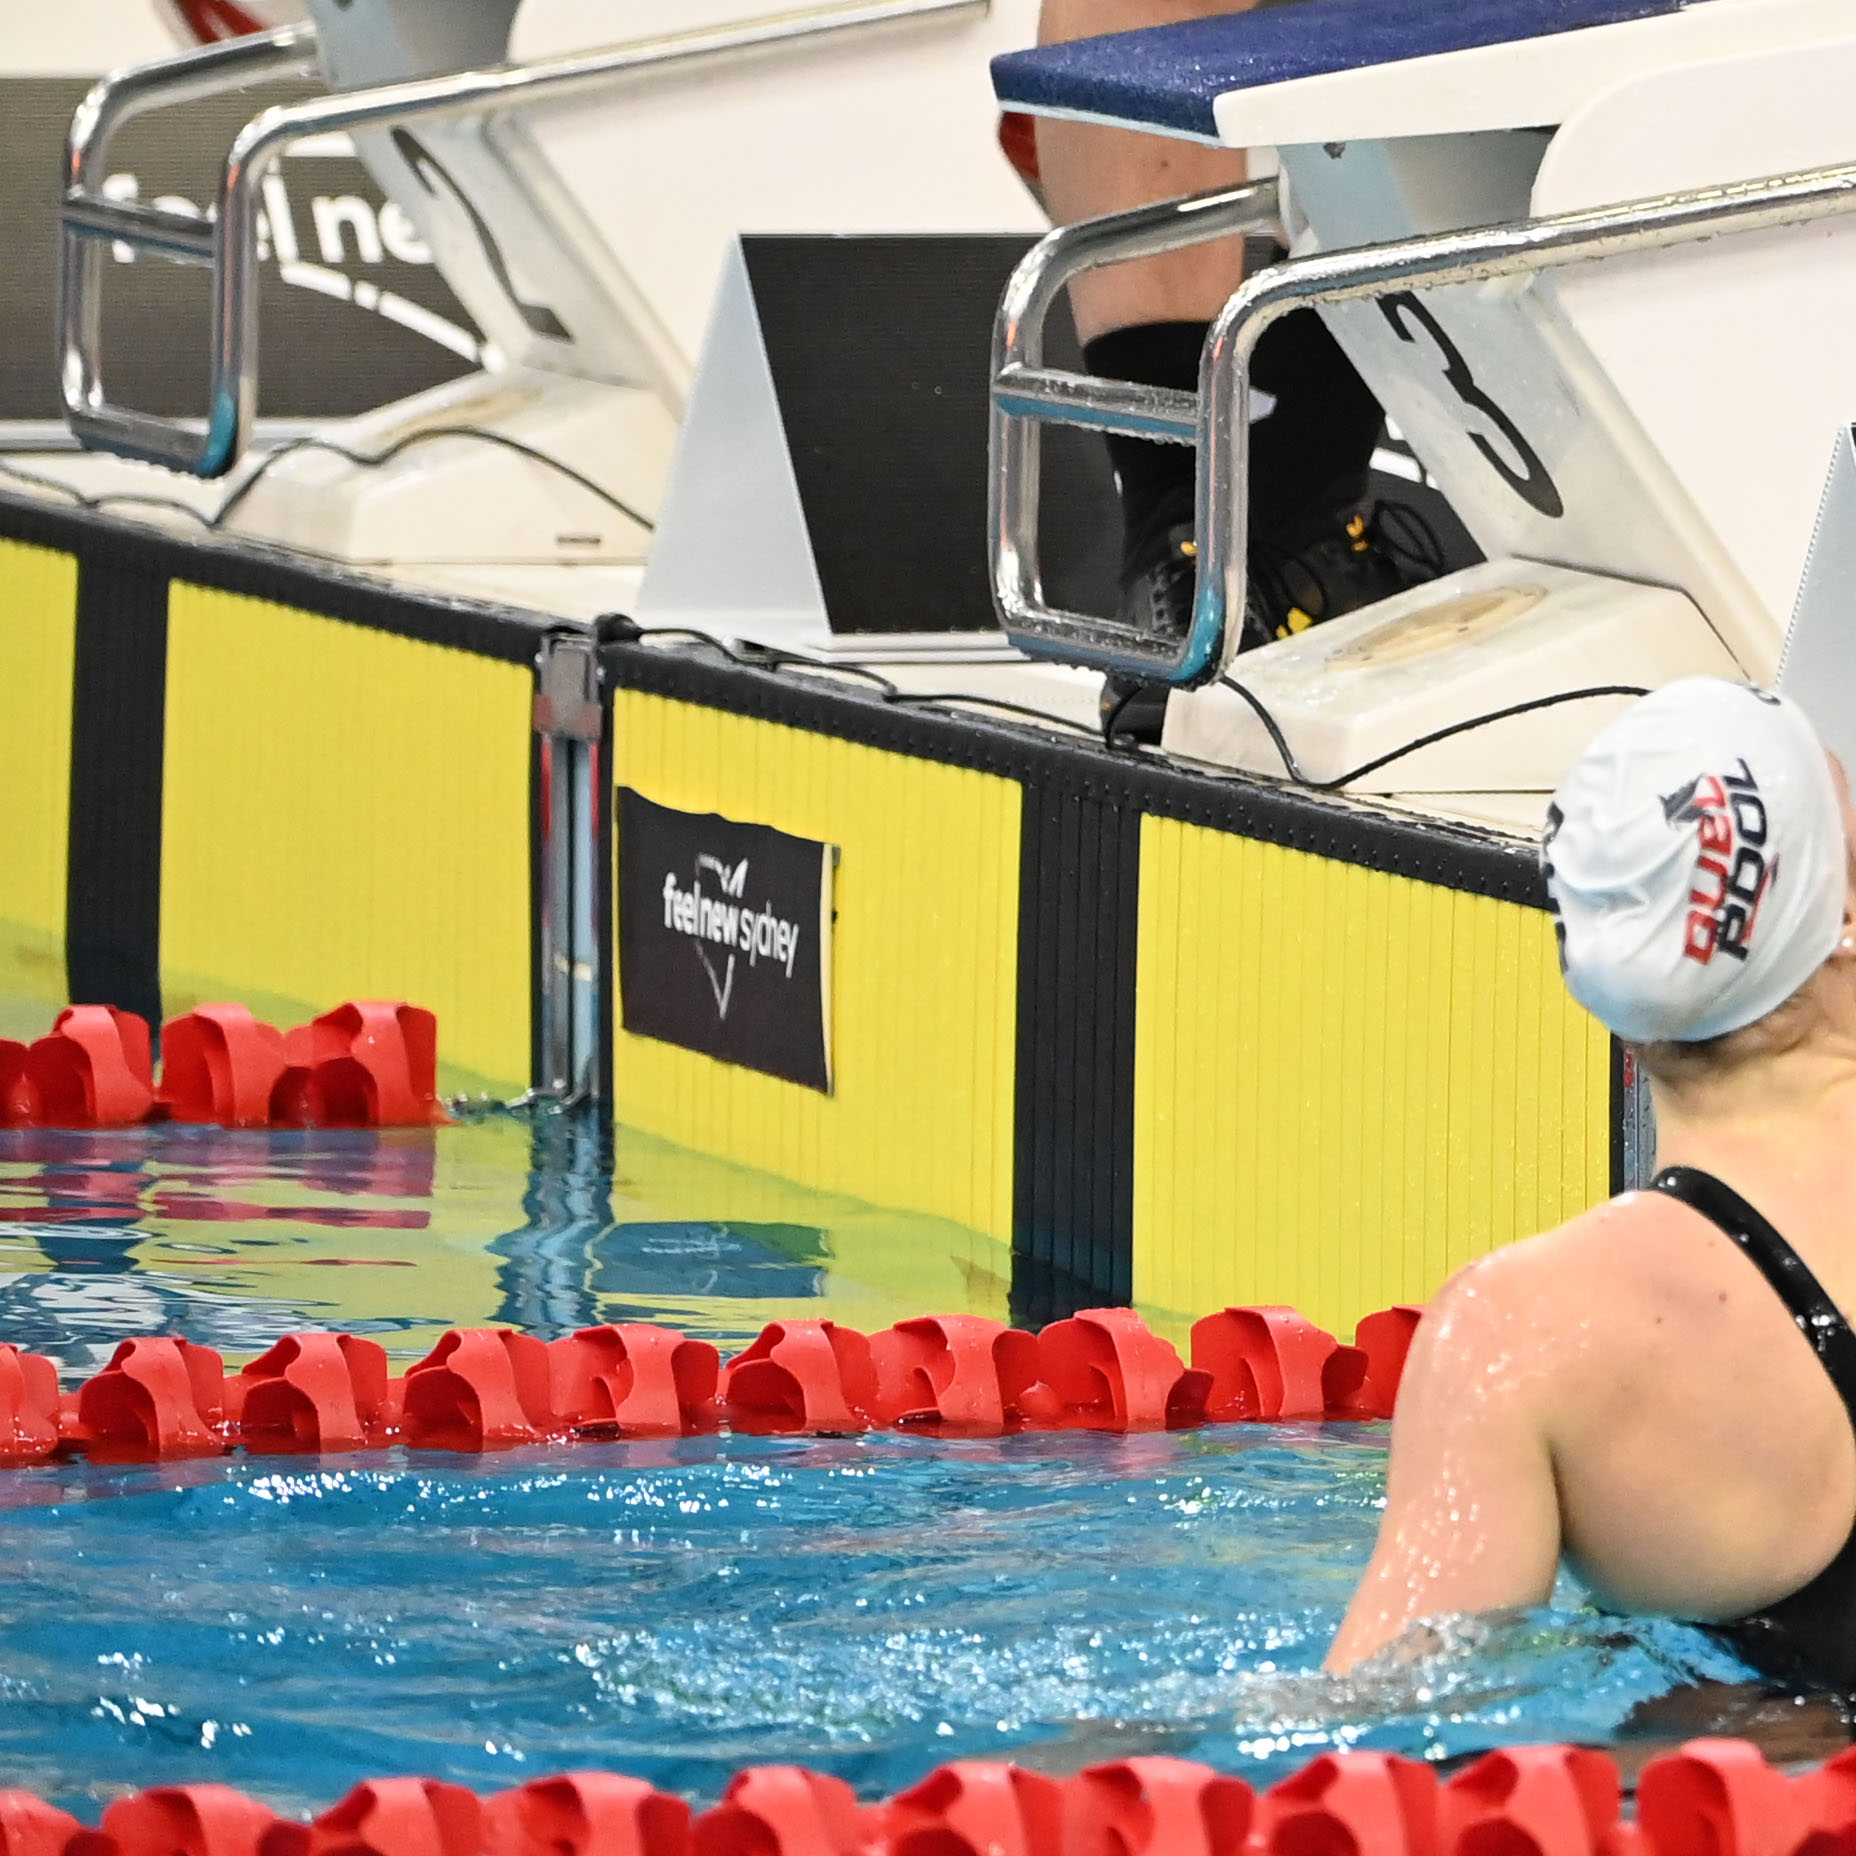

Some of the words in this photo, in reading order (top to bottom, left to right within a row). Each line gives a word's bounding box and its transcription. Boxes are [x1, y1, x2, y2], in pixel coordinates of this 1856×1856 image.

[311, 194, 440, 263] ne
[391, 126, 574, 343] 2
[1375, 291, 1564, 519] 3
[662, 871, 700, 937] feel
[700, 897, 740, 947] new
[739, 899, 799, 979] sydney
[1682, 774, 1735, 966] DUEL
[1715, 756, 1768, 962] POOL
